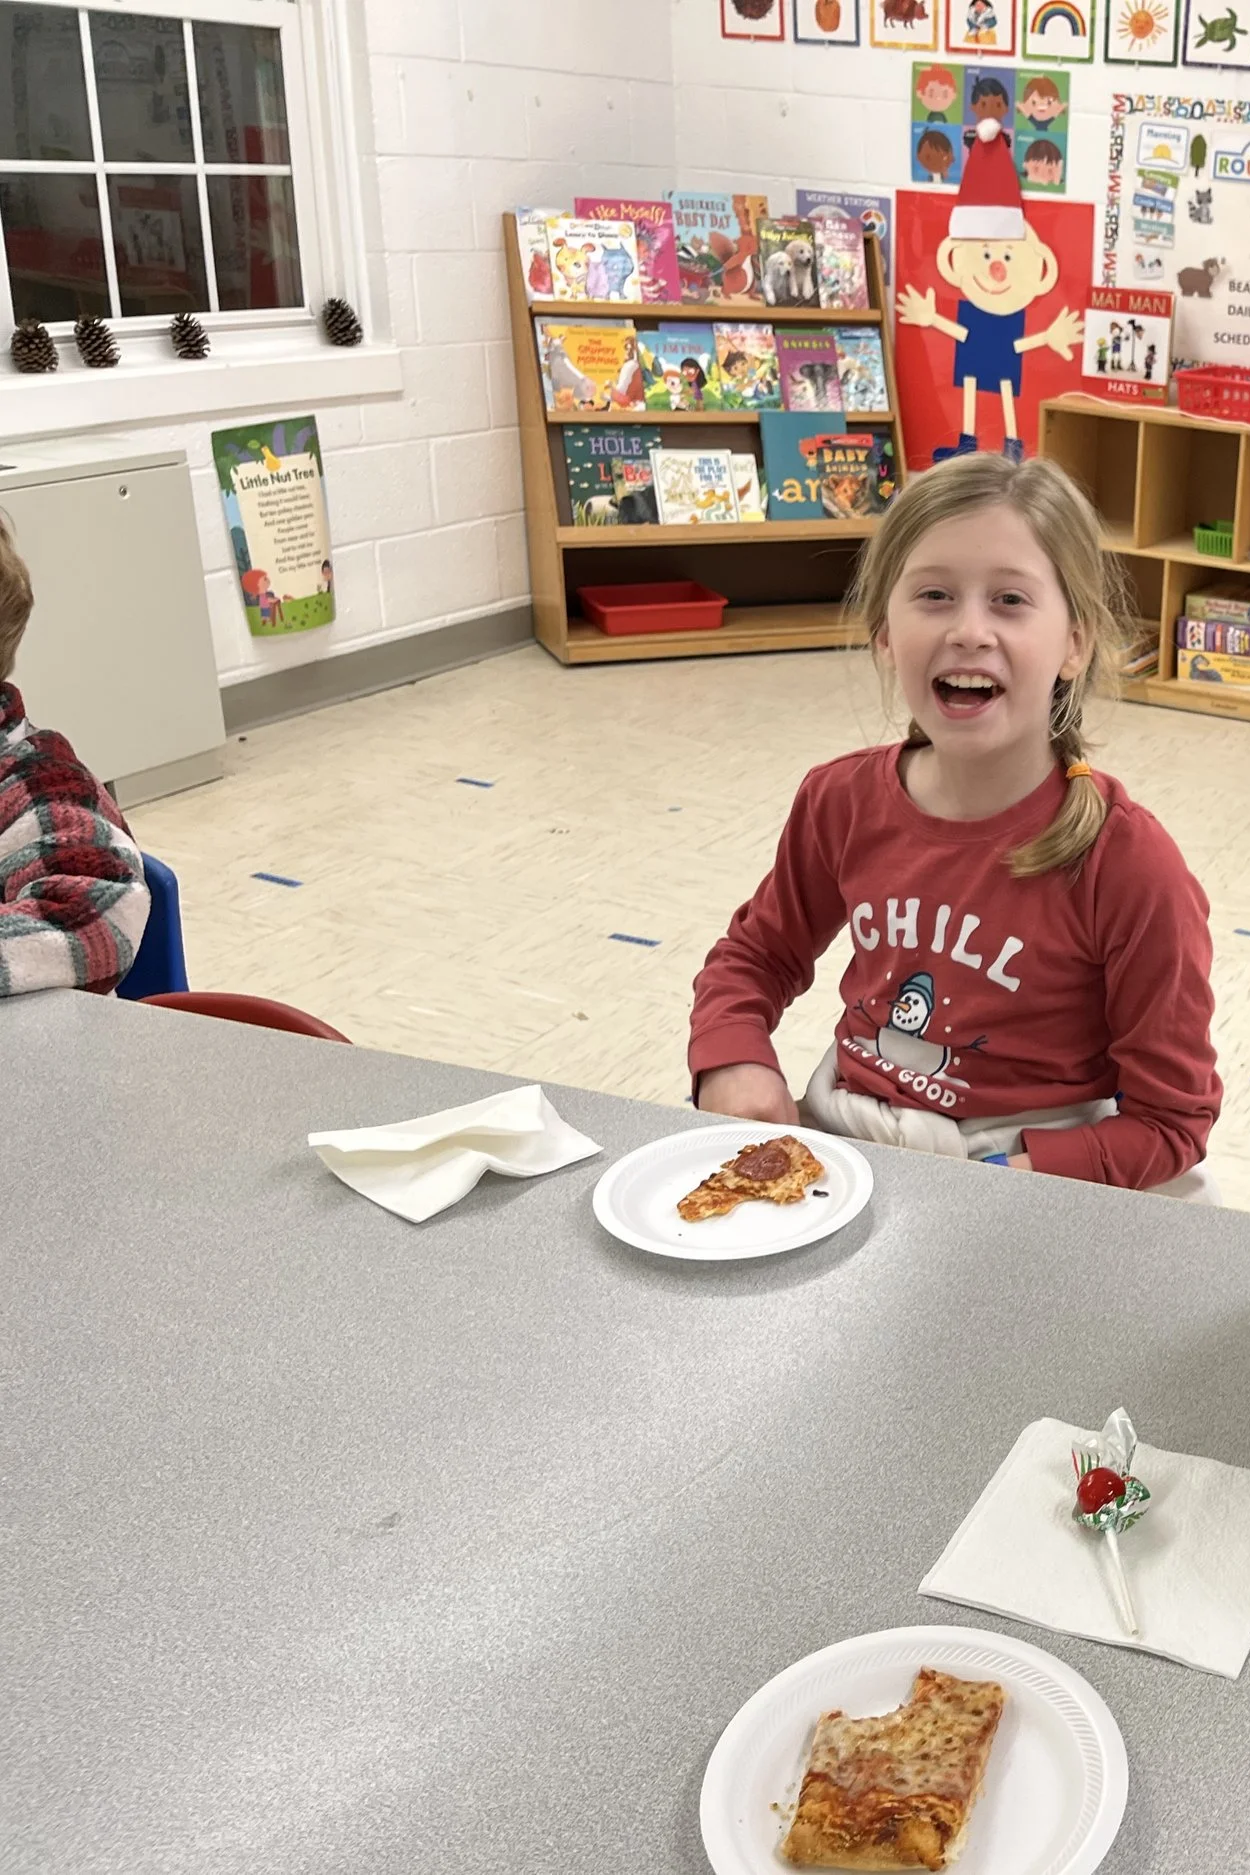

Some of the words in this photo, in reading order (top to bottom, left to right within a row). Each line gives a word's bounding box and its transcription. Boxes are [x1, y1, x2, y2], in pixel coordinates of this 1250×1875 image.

[806, 192, 842, 206] WEATHER
[709, 214, 732, 230] DAY
[1091, 291, 1122, 309] MAT
[1128, 295, 1166, 314] MAN
[1108, 382, 1138, 395] HATS
[589, 436, 643, 455] HOLE
[823, 448, 869, 463] BABY
[240, 474, 269, 490] Little
[270, 472, 292, 484] Nut
[292, 468, 315, 480] Tree
[623, 462, 653, 482] Be
[782, 478, 822, 503] ar
[852, 897, 1024, 993] CHILL
[898, 1069, 957, 1108] GOOD
